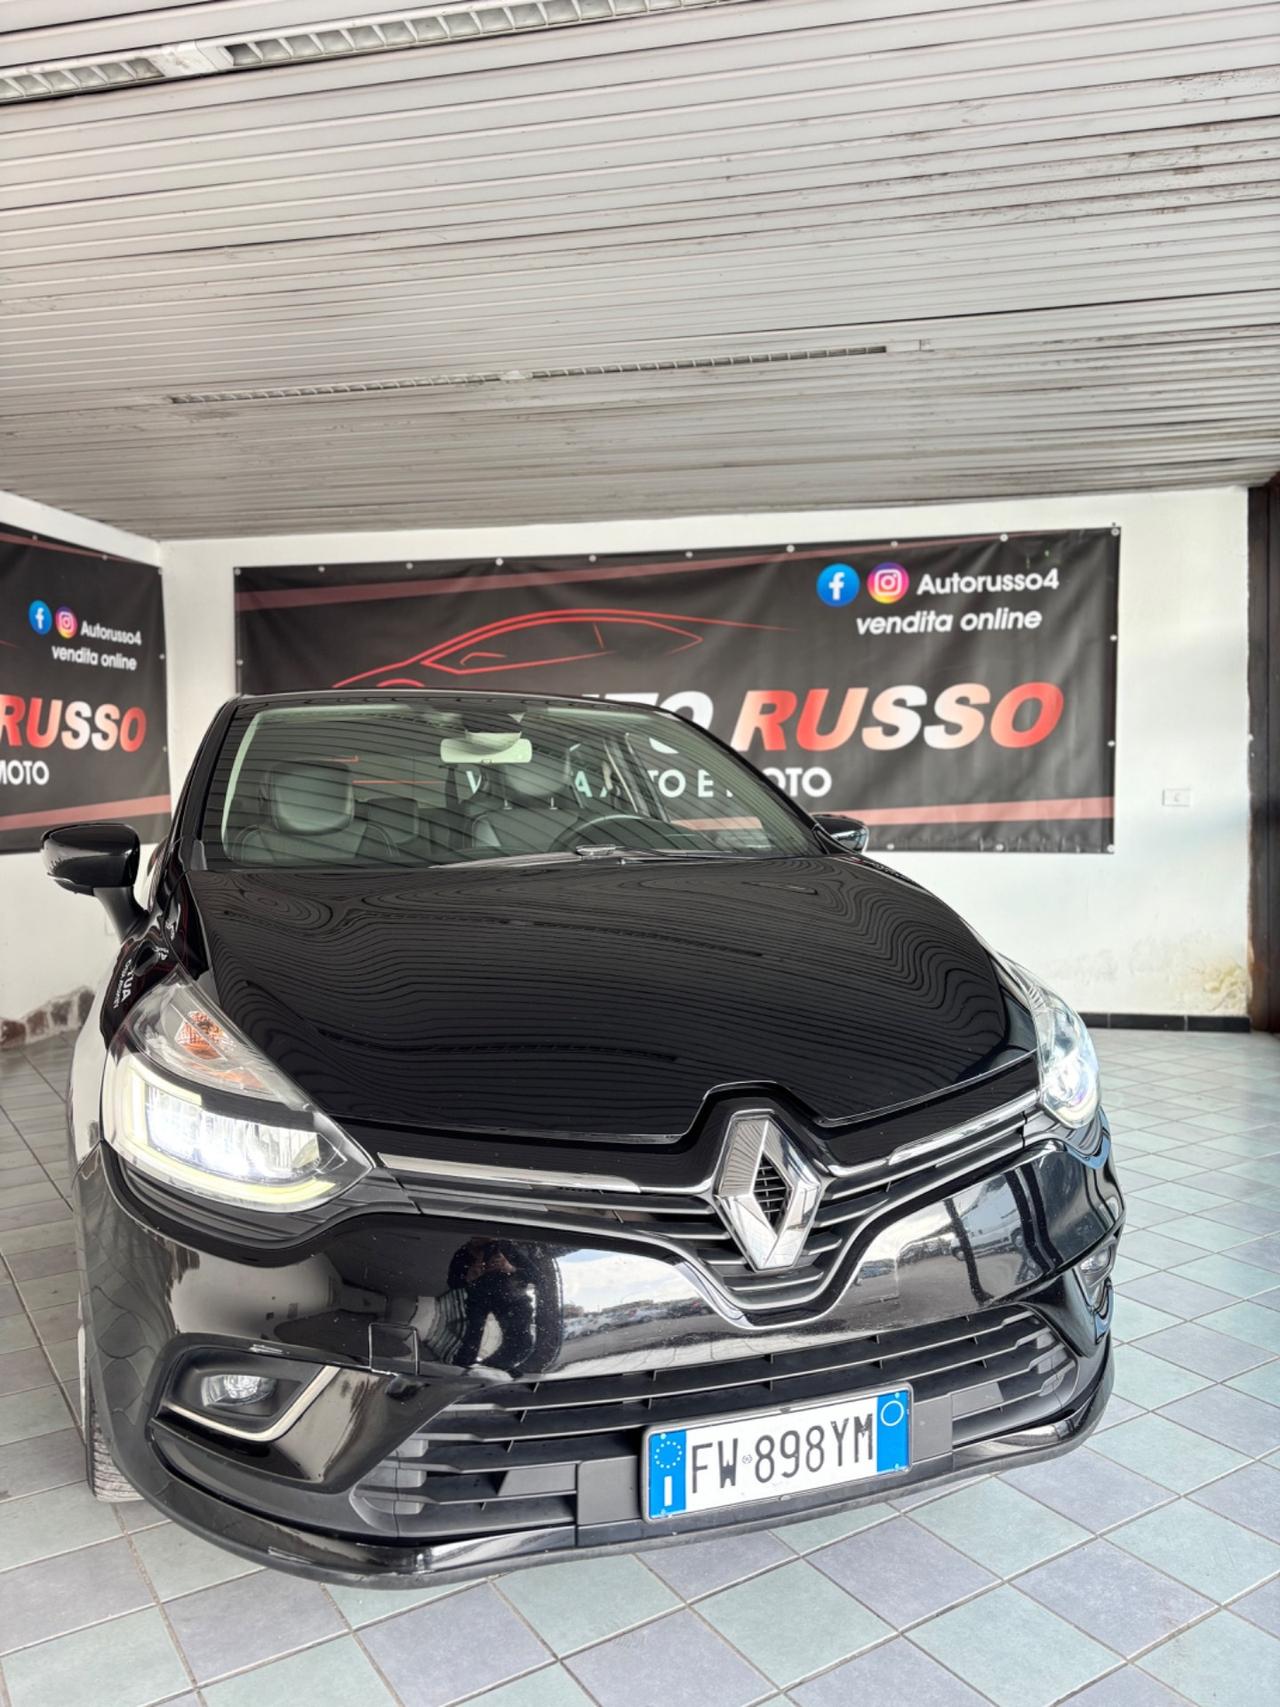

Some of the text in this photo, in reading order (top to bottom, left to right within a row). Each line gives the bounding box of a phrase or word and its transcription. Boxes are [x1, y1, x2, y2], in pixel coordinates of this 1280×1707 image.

[916, 567, 1060, 597] Autorusso4
[80, 620, 143, 646] Autorusso4
[856, 607, 1043, 635] vendita online
[52, 644, 138, 671] vendita online
[0, 693, 147, 753] RUSSO
[730, 681, 1065, 752] RUSSO
[691, 1413, 874, 1494] FW 898YM
